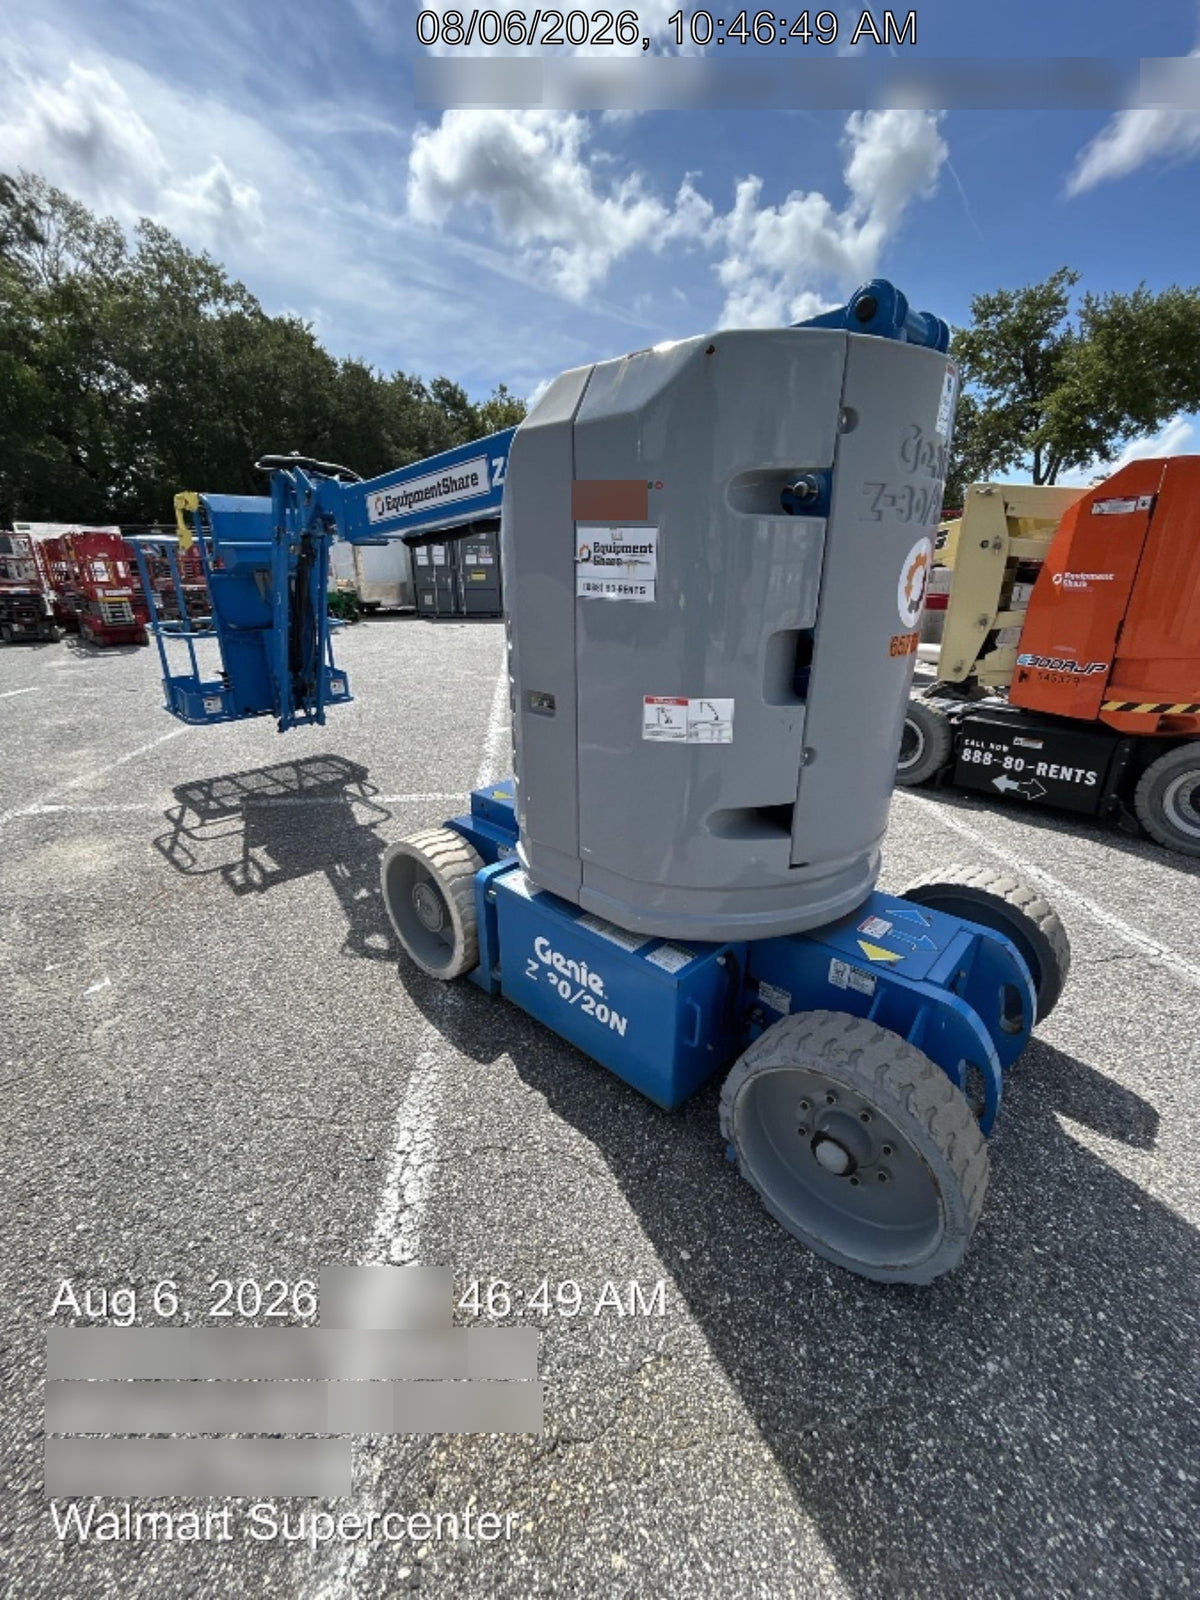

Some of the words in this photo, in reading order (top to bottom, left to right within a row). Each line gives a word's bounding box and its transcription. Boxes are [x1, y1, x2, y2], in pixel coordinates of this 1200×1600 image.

[384, 472, 479, 513] EquipmentShare
[593, 542, 654, 555] Equipment
[964, 739, 985, 748] CALL
[990, 743, 1009, 752] NOW
[534, 936, 604, 997] Genie
